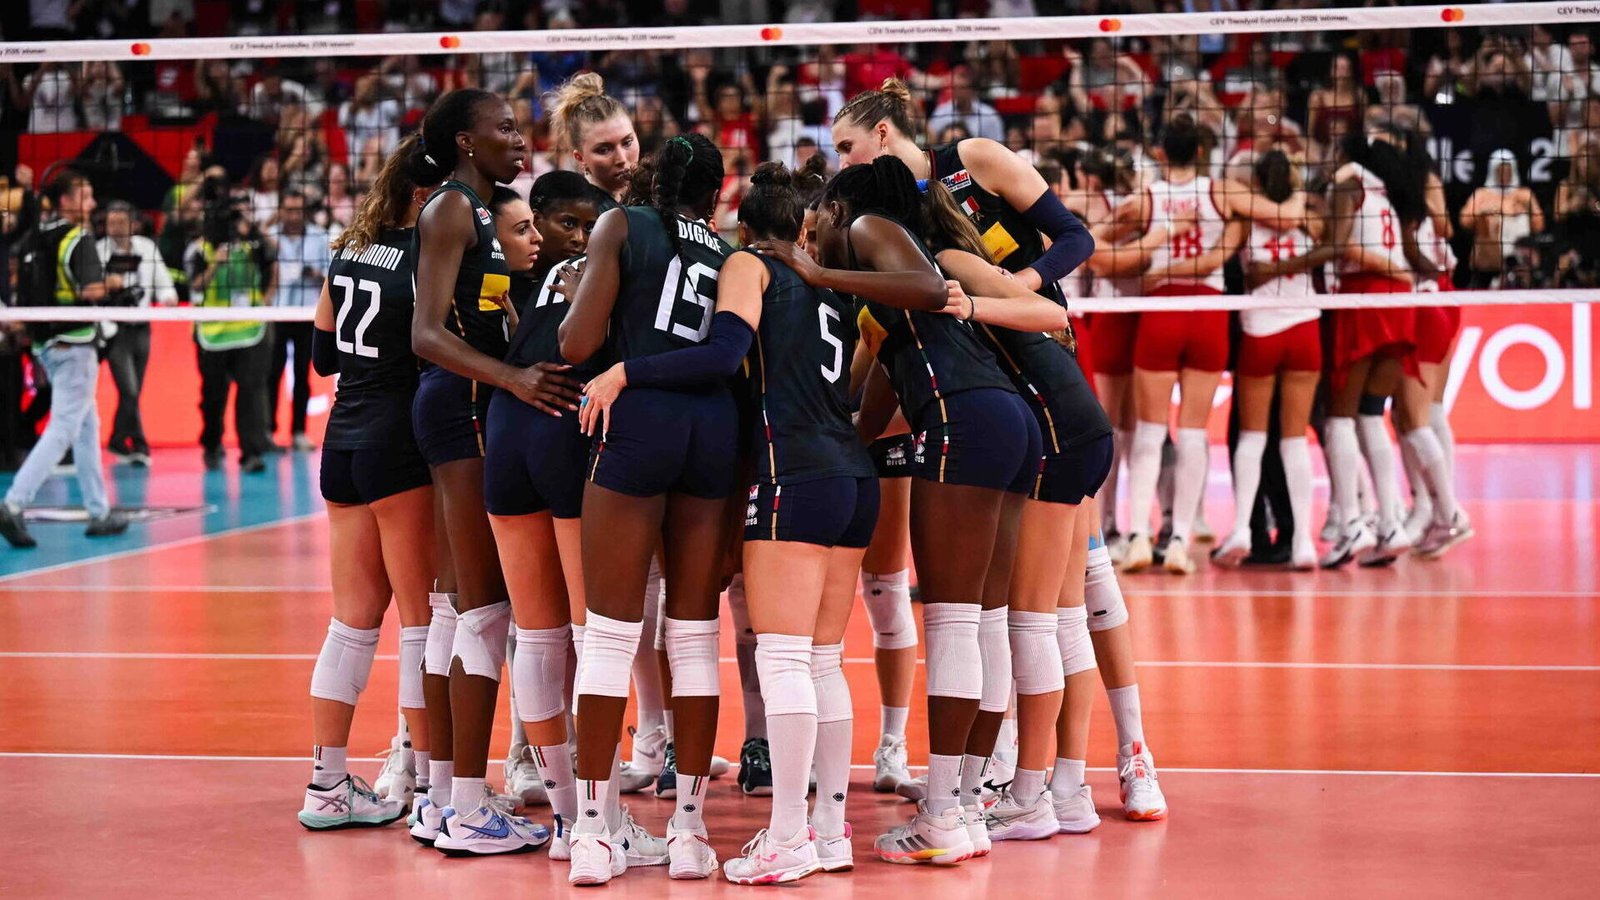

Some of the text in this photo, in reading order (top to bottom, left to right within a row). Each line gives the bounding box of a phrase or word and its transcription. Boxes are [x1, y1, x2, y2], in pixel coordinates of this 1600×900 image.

[1210, 18, 1225, 26] CEV
[1227, 17, 1258, 26] Trendyol
[1260, 16, 1298, 25] EuroVolley
[1320, 14, 1348, 22] Women
[1557, 7, 1574, 15] CEV
[1380, 208, 1396, 249] 8
[332, 274, 381, 359] 22
[653, 253, 720, 343] 15
[816, 302, 843, 385] 5
